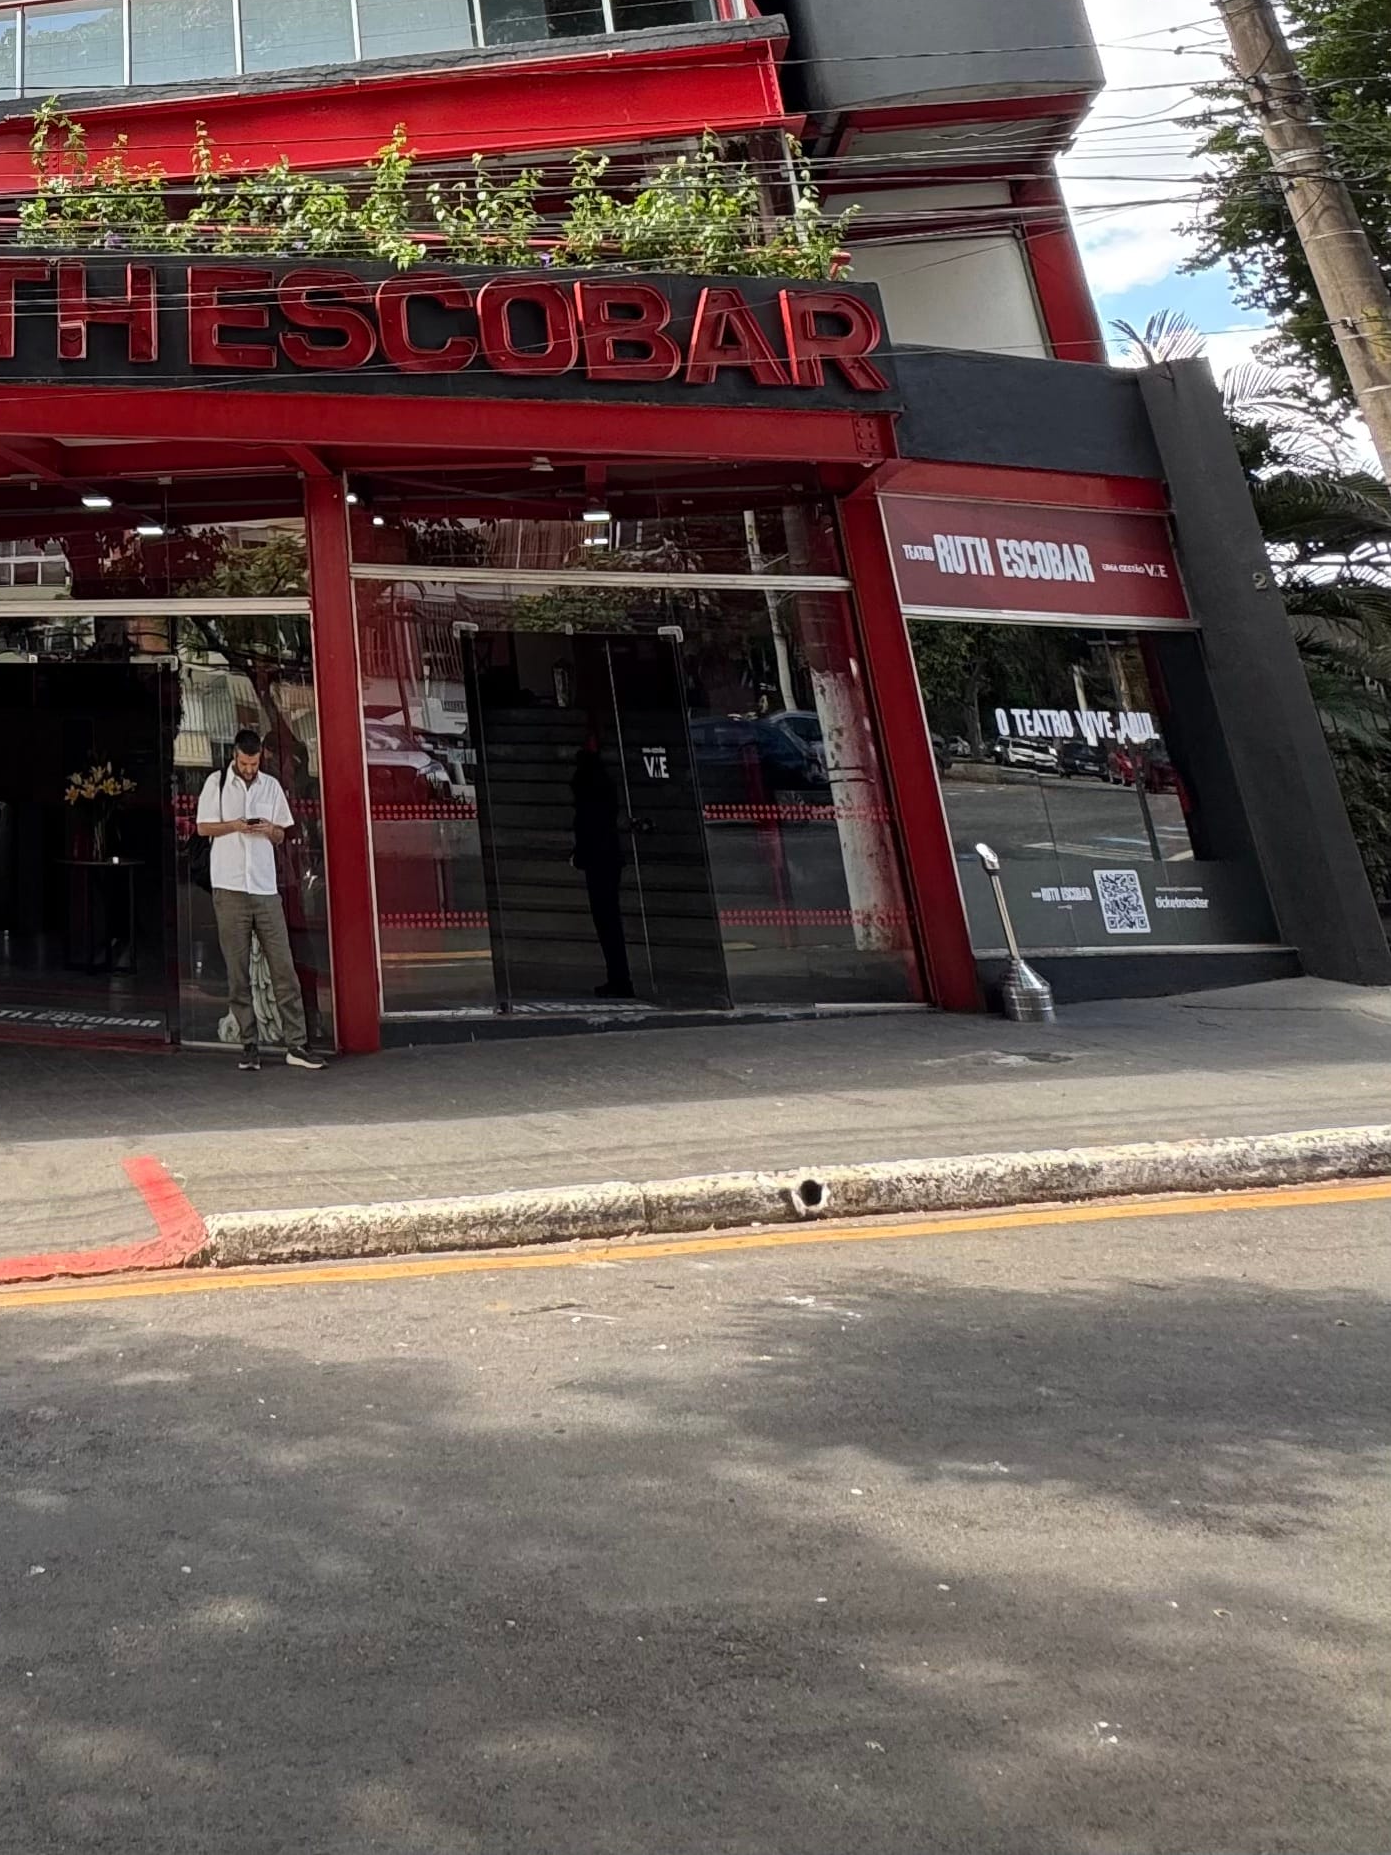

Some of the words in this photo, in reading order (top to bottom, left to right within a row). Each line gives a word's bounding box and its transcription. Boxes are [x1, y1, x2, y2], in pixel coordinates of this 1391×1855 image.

[186, 264, 891, 392] ESCOBAR
[932, 534, 996, 577] RUTH
[995, 538, 1096, 583] ESCOBAR
[1252, 571, 1268, 590] 2
[994, 708, 1010, 736] O
[1010, 708, 1075, 738] TEATRO
[1074, 710, 1116, 739] VIVE
[34, 1013, 162, 1028] ESCOBAR
